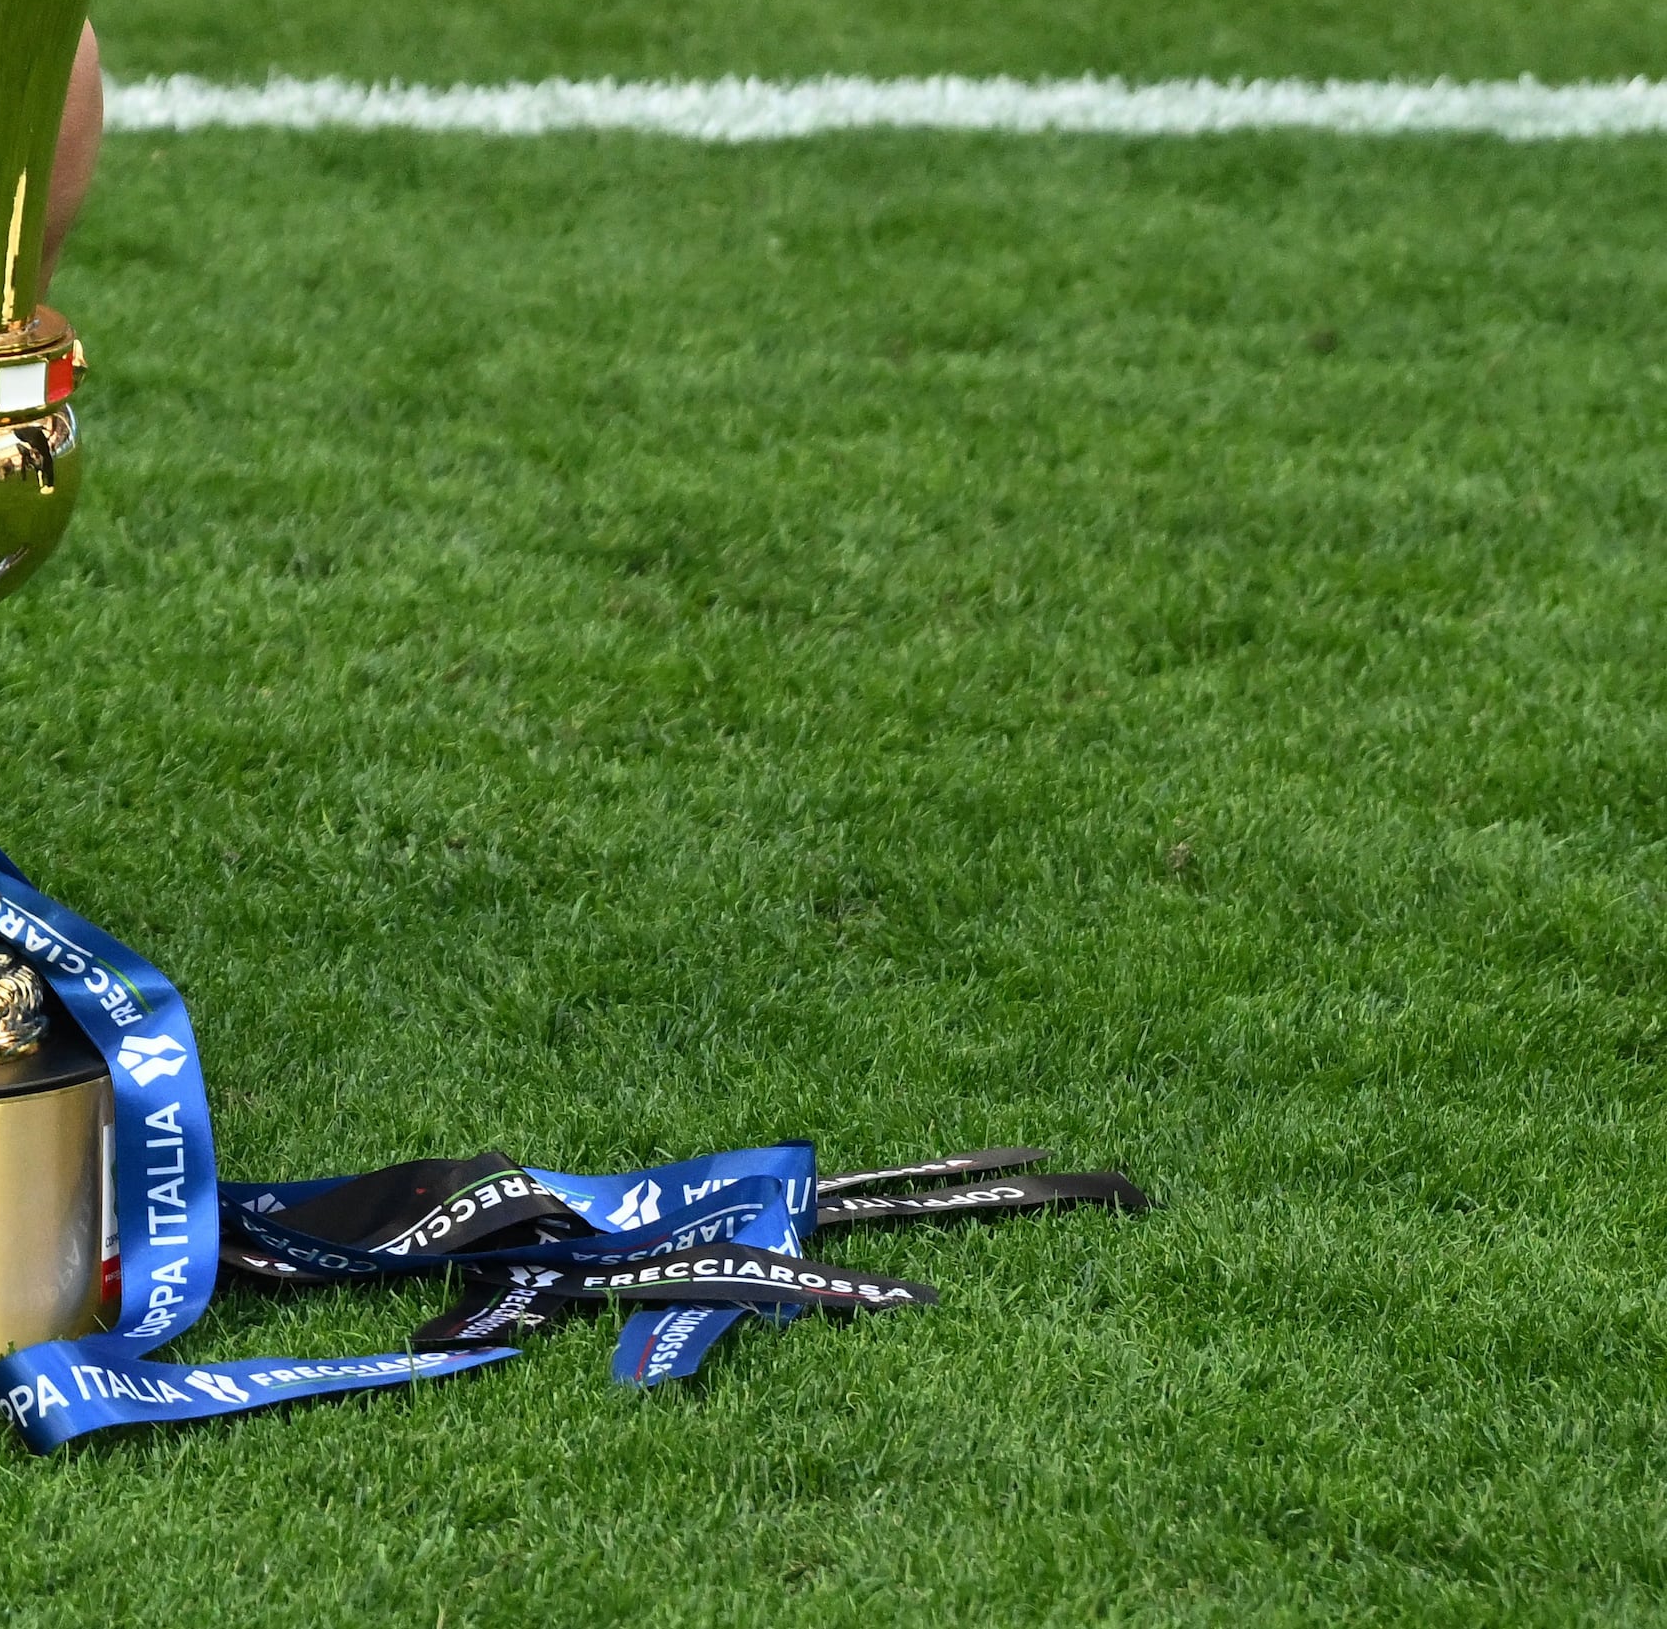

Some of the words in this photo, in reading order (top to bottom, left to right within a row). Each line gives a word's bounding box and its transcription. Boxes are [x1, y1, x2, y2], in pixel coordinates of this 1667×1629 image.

[145, 1101, 189, 1246] ITALIA
[123, 1256, 190, 1338] COPPA
[583, 1257, 914, 1300] FRECCIAROSSA
[70, 1365, 193, 1404] ITALIA
